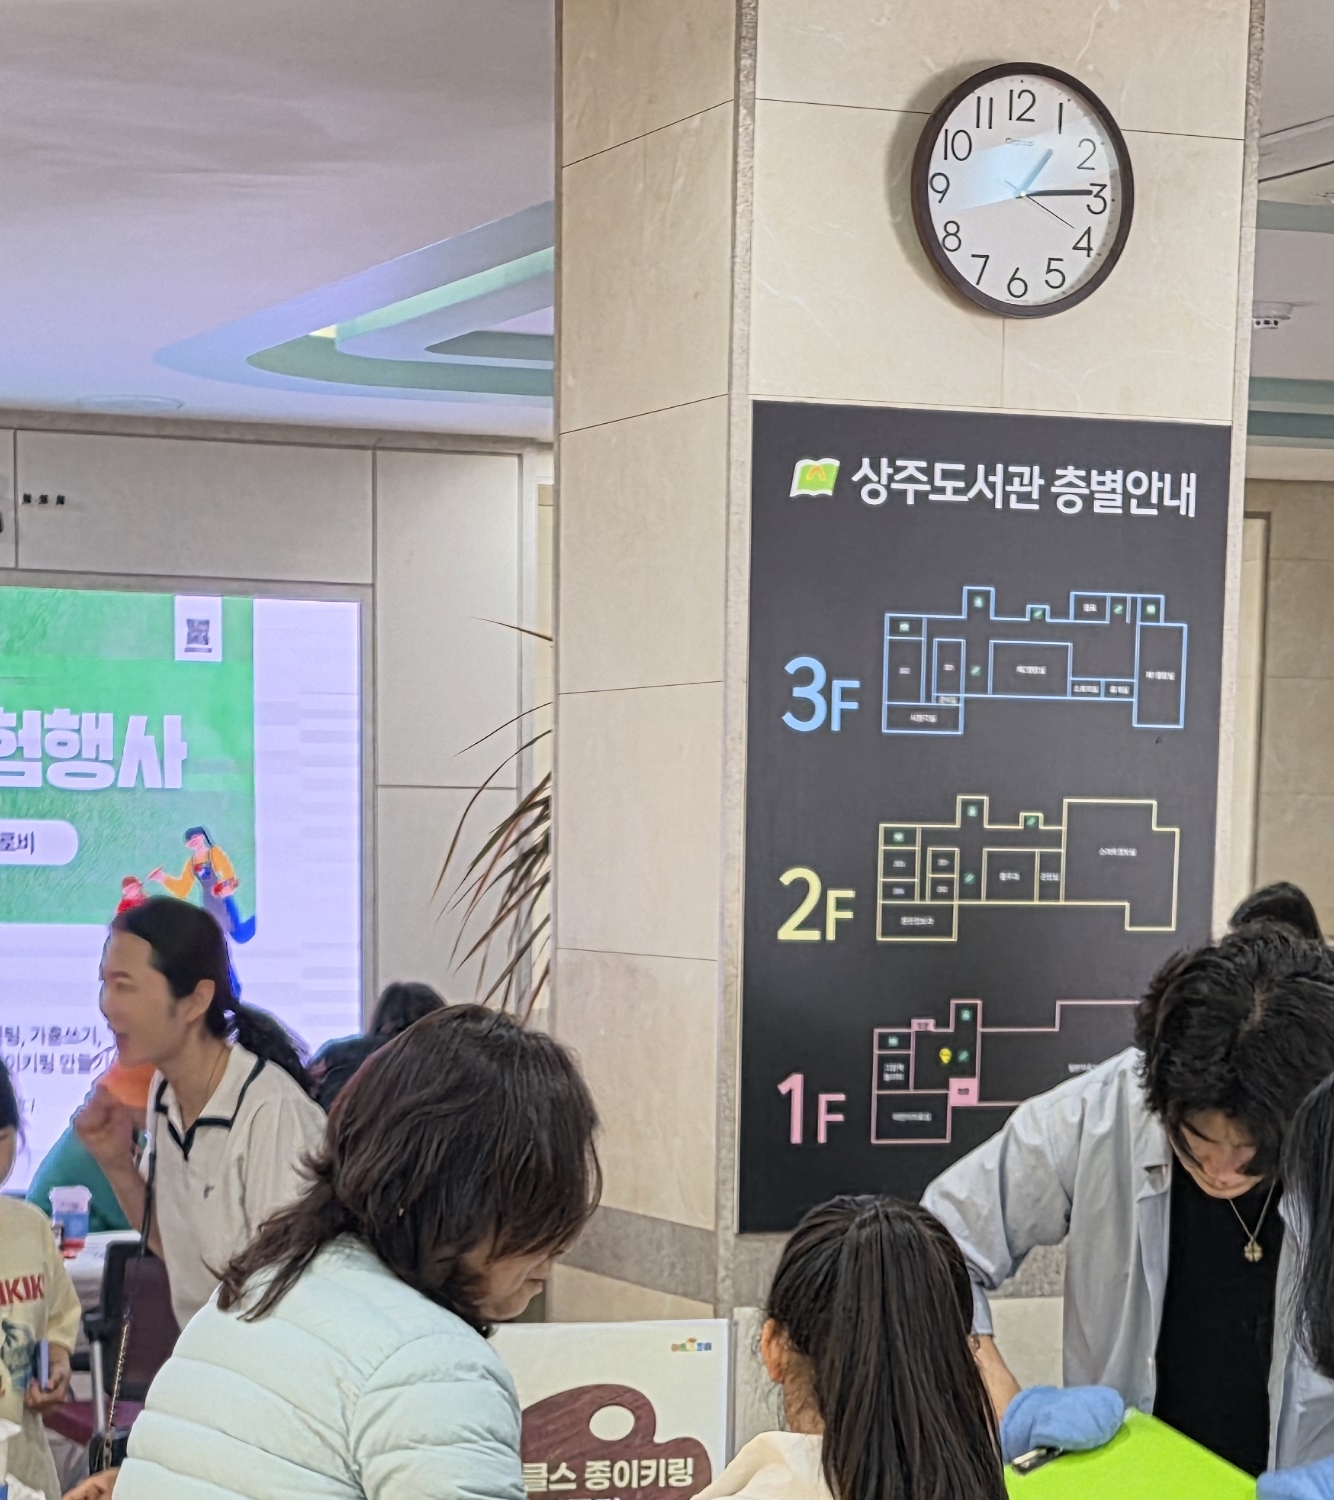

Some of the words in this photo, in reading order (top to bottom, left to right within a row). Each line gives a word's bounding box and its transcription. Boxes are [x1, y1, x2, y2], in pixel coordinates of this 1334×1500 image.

[975, 96, 994, 129] 11
[1008, 89, 1037, 122] 12
[1058, 102, 1063, 134] 1
[943, 129, 973, 161] 10
[1076, 138, 1097, 170] 2
[930, 172, 950, 204] 9
[1086, 183, 1108, 215] 3
[942, 221, 962, 252] 8
[1072, 226, 1094, 258] 4
[971, 254, 990, 286] 7
[1007, 267, 1028, 298] 6
[1045, 258, 1066, 289] 5
[851, 457, 1044, 510] 상주도서관
[1051, 465, 1197, 518] 층별안내
[782, 657, 861, 734] 3F
[777, 868, 856, 942] 2F
[5, 1053, 54, 1075] 이키링
[777, 1074, 847, 1144] 1F
[522, 1461, 577, 1492] 클스
[584, 1457, 694, 1490] 종이키링
